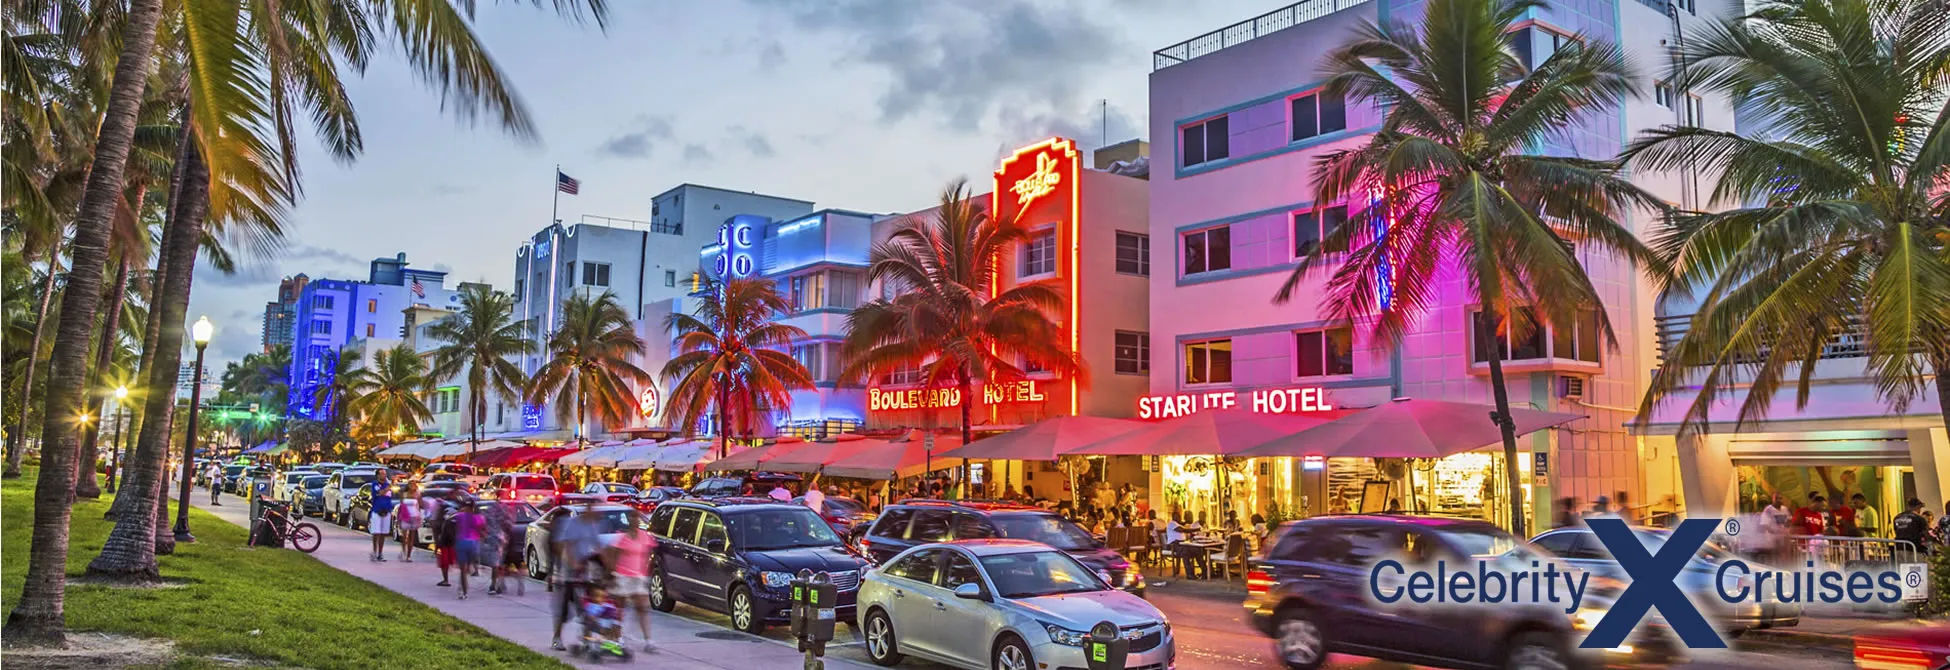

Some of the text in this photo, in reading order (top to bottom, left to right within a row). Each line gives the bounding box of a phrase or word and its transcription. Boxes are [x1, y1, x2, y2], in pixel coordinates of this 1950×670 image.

[870, 380, 1044, 410] BOULEVARD HOTEL
[1252, 387, 1332, 414] HOTEL
